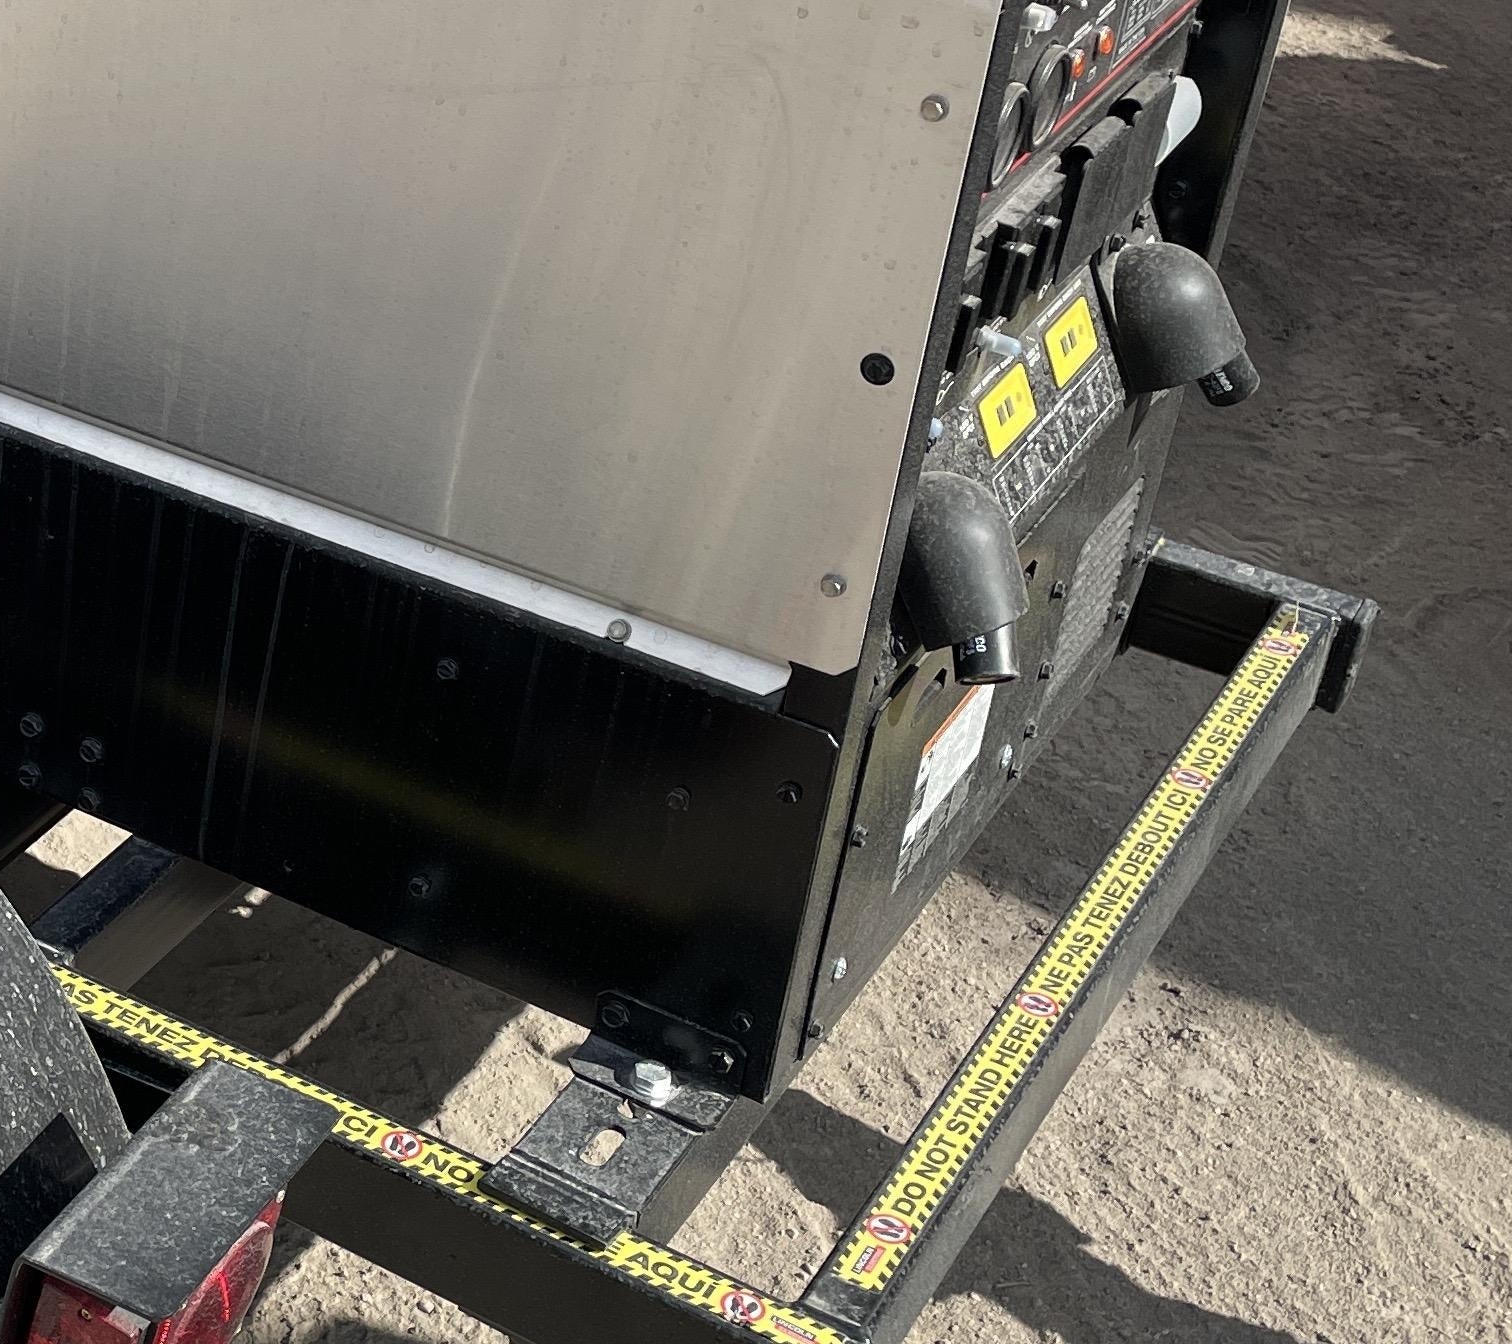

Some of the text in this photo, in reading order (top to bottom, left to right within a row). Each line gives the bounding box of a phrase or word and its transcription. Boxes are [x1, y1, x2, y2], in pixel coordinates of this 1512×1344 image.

[892, 1182, 926, 1216] DO
[914, 1134, 958, 1182] NOT
[946, 1068, 1003, 1136] STAND
[990, 1013, 1039, 1068] HERE
[1038, 966, 1071, 995] NE
[1057, 931, 1095, 968] PAS
[1081, 875, 1133, 930] TENEZ
[1119, 810, 1175, 877] DEBOUT
[1166, 788, 1192, 812] ICI
[1190, 747, 1219, 771] NO
[1206, 726, 1233, 747] SE
[1220, 687, 1259, 727] PARE
[103, 999, 201, 1053] TENEZ
[421, 1152, 475, 1183] NO
